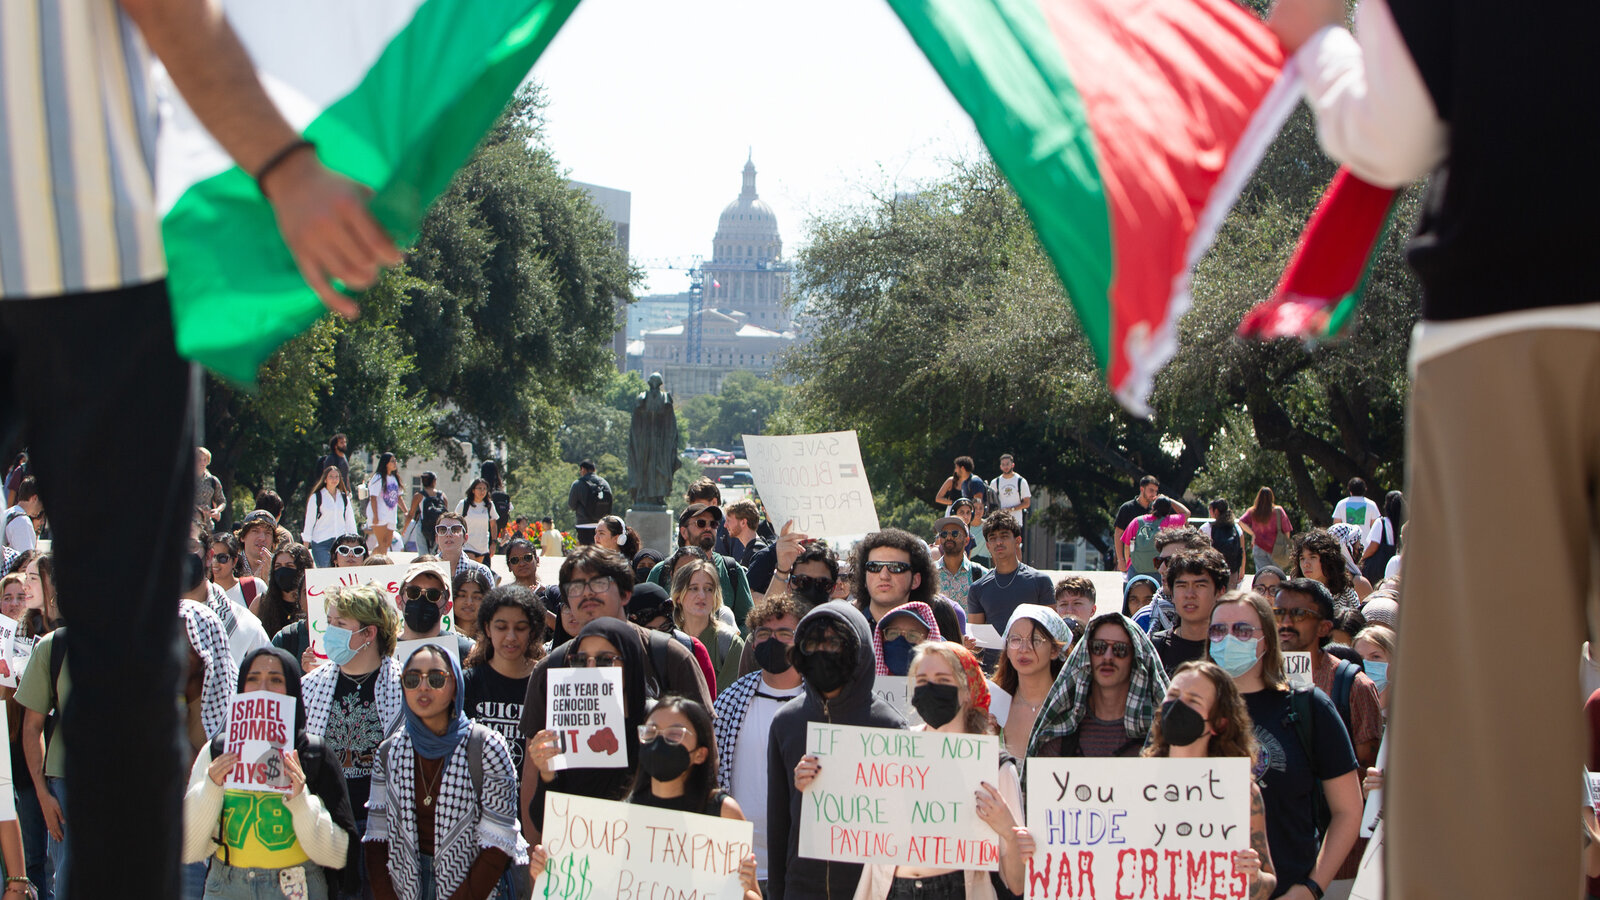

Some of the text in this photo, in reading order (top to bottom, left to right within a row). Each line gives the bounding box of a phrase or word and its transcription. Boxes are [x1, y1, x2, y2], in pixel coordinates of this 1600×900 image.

[553, 682, 614, 697] ONE YEAR OF
[553, 698, 600, 711] GENOCIDE
[231, 698, 283, 722] ISRAEL
[552, 712, 607, 727] FUNDED BY
[229, 720, 287, 745] BOMBS
[552, 729, 579, 754] UT
[812, 727, 842, 756] IF
[941, 736, 990, 761] NOT
[855, 761, 931, 791] ANGRY
[1052, 770, 1114, 803] You
[223, 791, 297, 852] 78
[911, 800, 963, 824] NOT
[548, 797, 751, 876] YOUR TAXPAYER
[1045, 808, 1238, 847] HIDE your
[830, 825, 1000, 866] PAYING ATTENTION
[1028, 847, 1248, 900] WAR CRIMES
